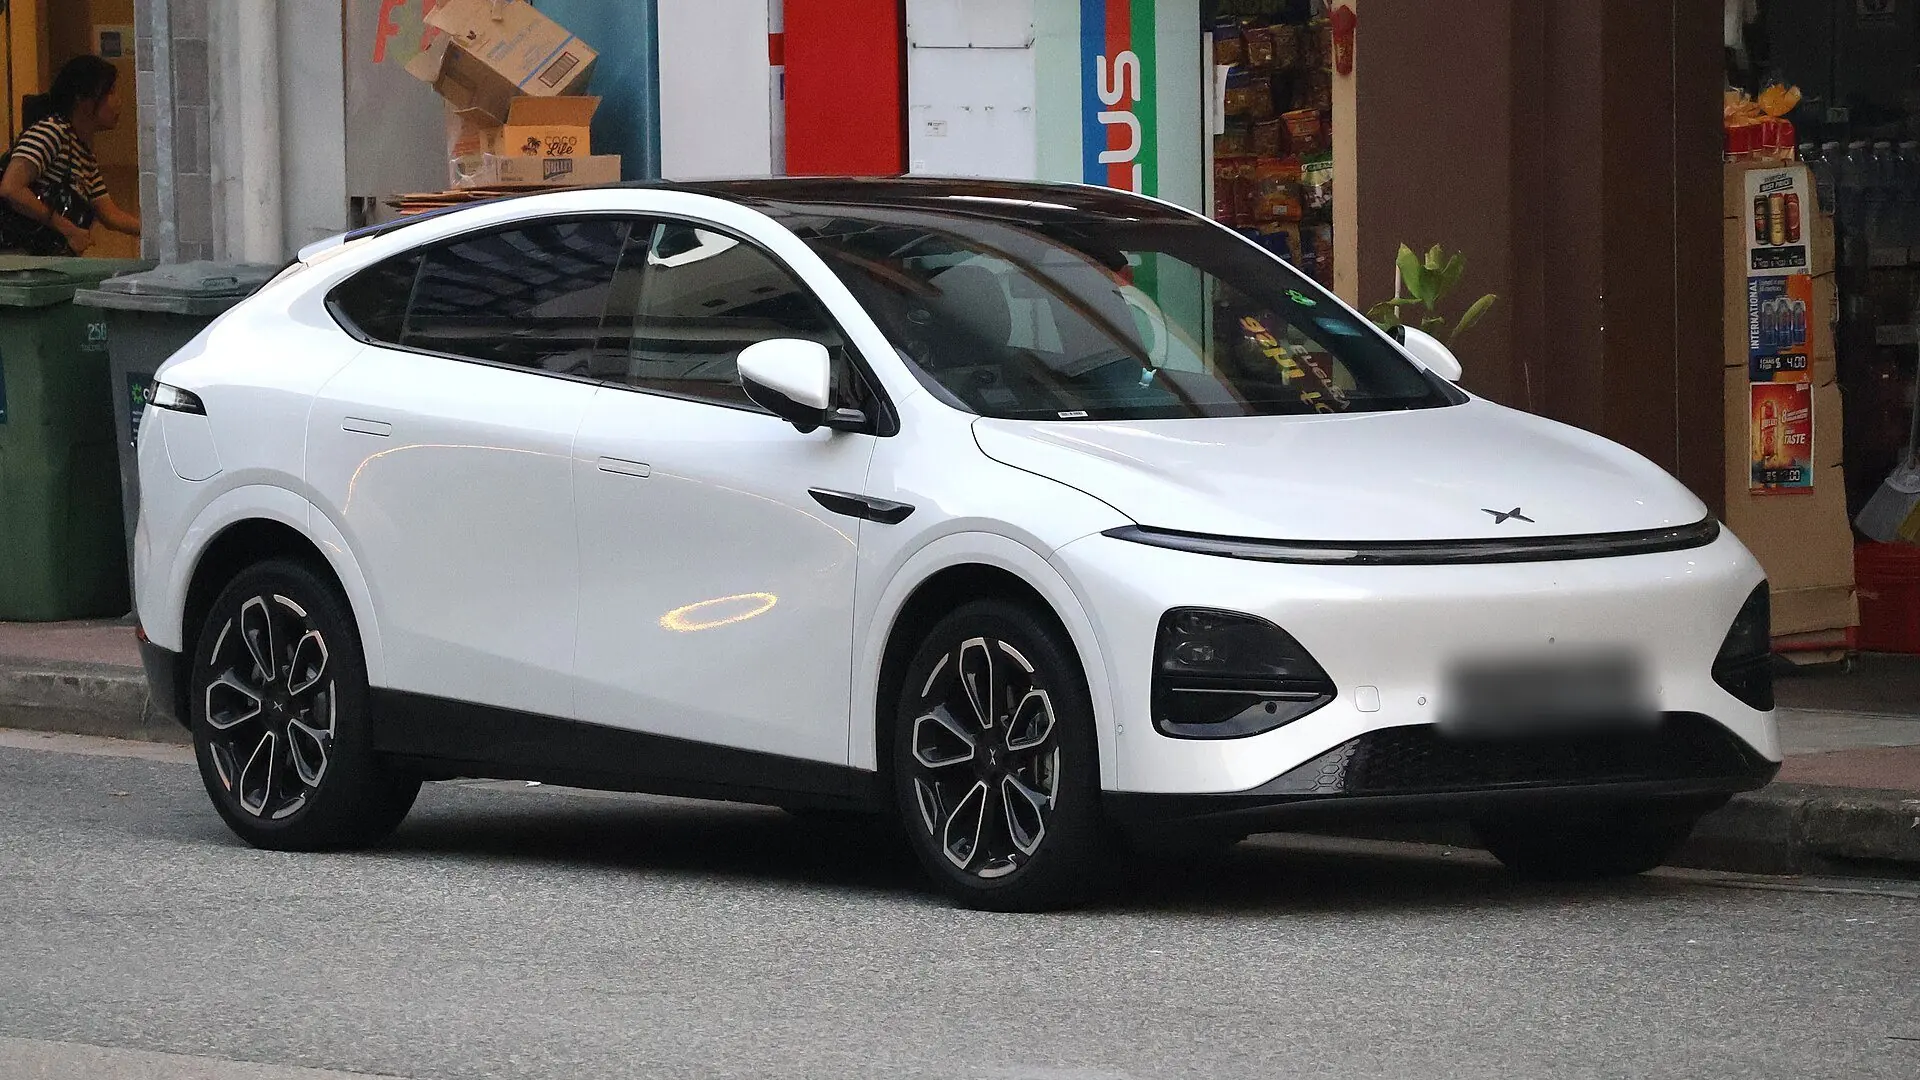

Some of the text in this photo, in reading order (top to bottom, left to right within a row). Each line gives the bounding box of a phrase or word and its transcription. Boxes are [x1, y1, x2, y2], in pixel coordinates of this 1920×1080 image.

[545, 136, 577, 146] COCO
[546, 142, 574, 156] Life
[1749, 280, 1760, 349] INTERNATIONAL
[1784, 433, 1806, 444] TASTE
